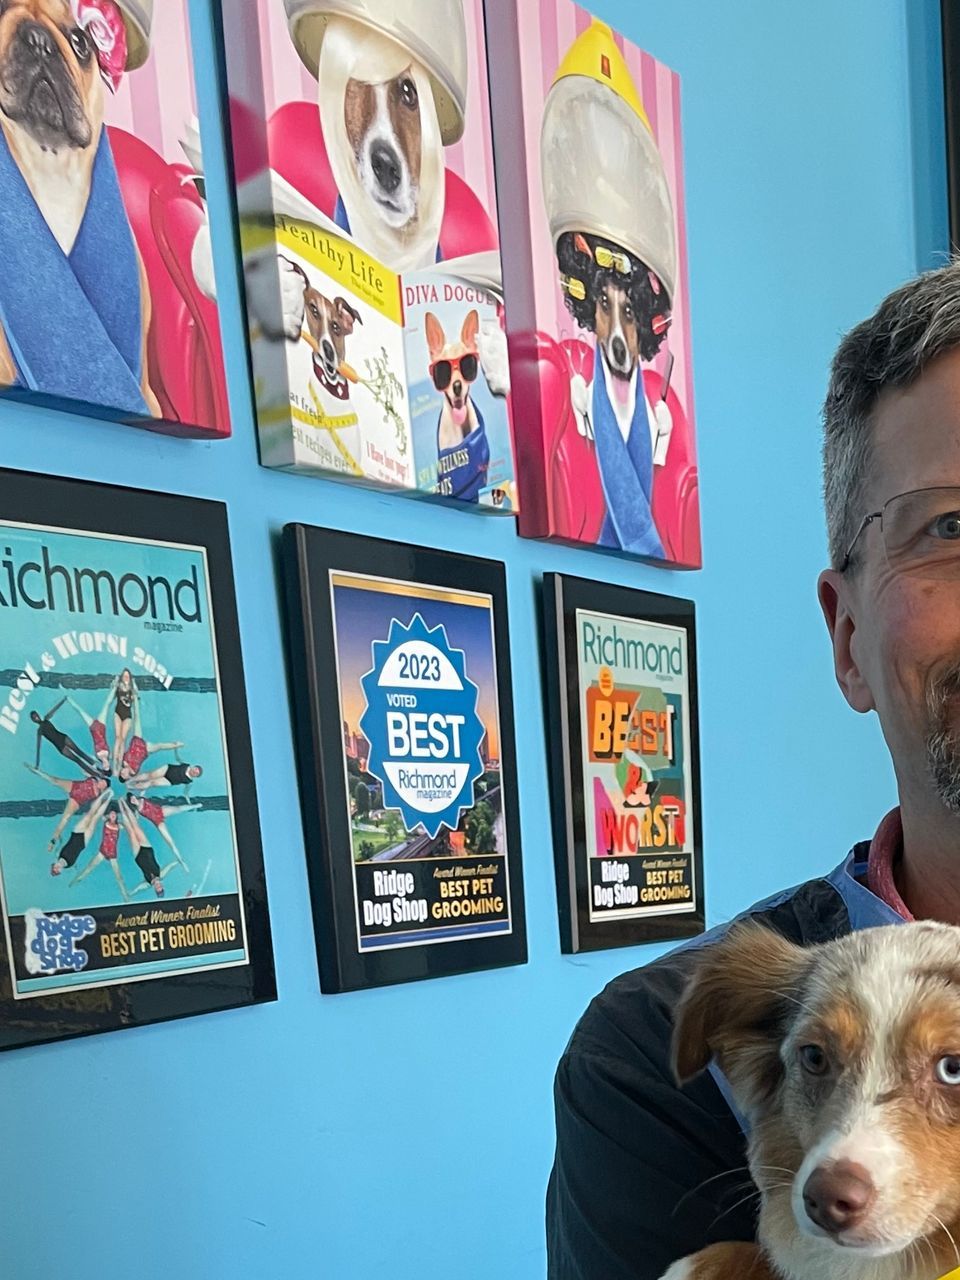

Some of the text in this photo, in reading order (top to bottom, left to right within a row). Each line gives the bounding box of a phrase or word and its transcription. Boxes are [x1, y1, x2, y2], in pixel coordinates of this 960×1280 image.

[349, 251, 384, 293] Life
[405, 284, 439, 307] DIVA
[144, 620, 184, 634] magazine
[52, 630, 128, 660] Worst
[583, 621, 683, 676] Richmond
[398, 653, 441, 681] 2023
[386, 693, 418, 708] VOTED
[386, 711, 466, 759] BEST
[398, 768, 457, 790] Richmond
[416, 789, 453, 802] magazine
[373, 869, 415, 897] Ridge
[600, 860, 630, 883] Ridge
[646, 869, 684, 885] BEST PET
[440, 878, 494, 898] BEST PET
[593, 883, 639, 908] Dog Shop
[640, 885, 690, 902] GROOMING
[115, 904, 221, 928] Award Winner Finalist
[362, 897, 429, 927] Dog Shop
[431, 896, 505, 919] GROOMING
[100, 919, 237, 958] BEST PET GROOMING
